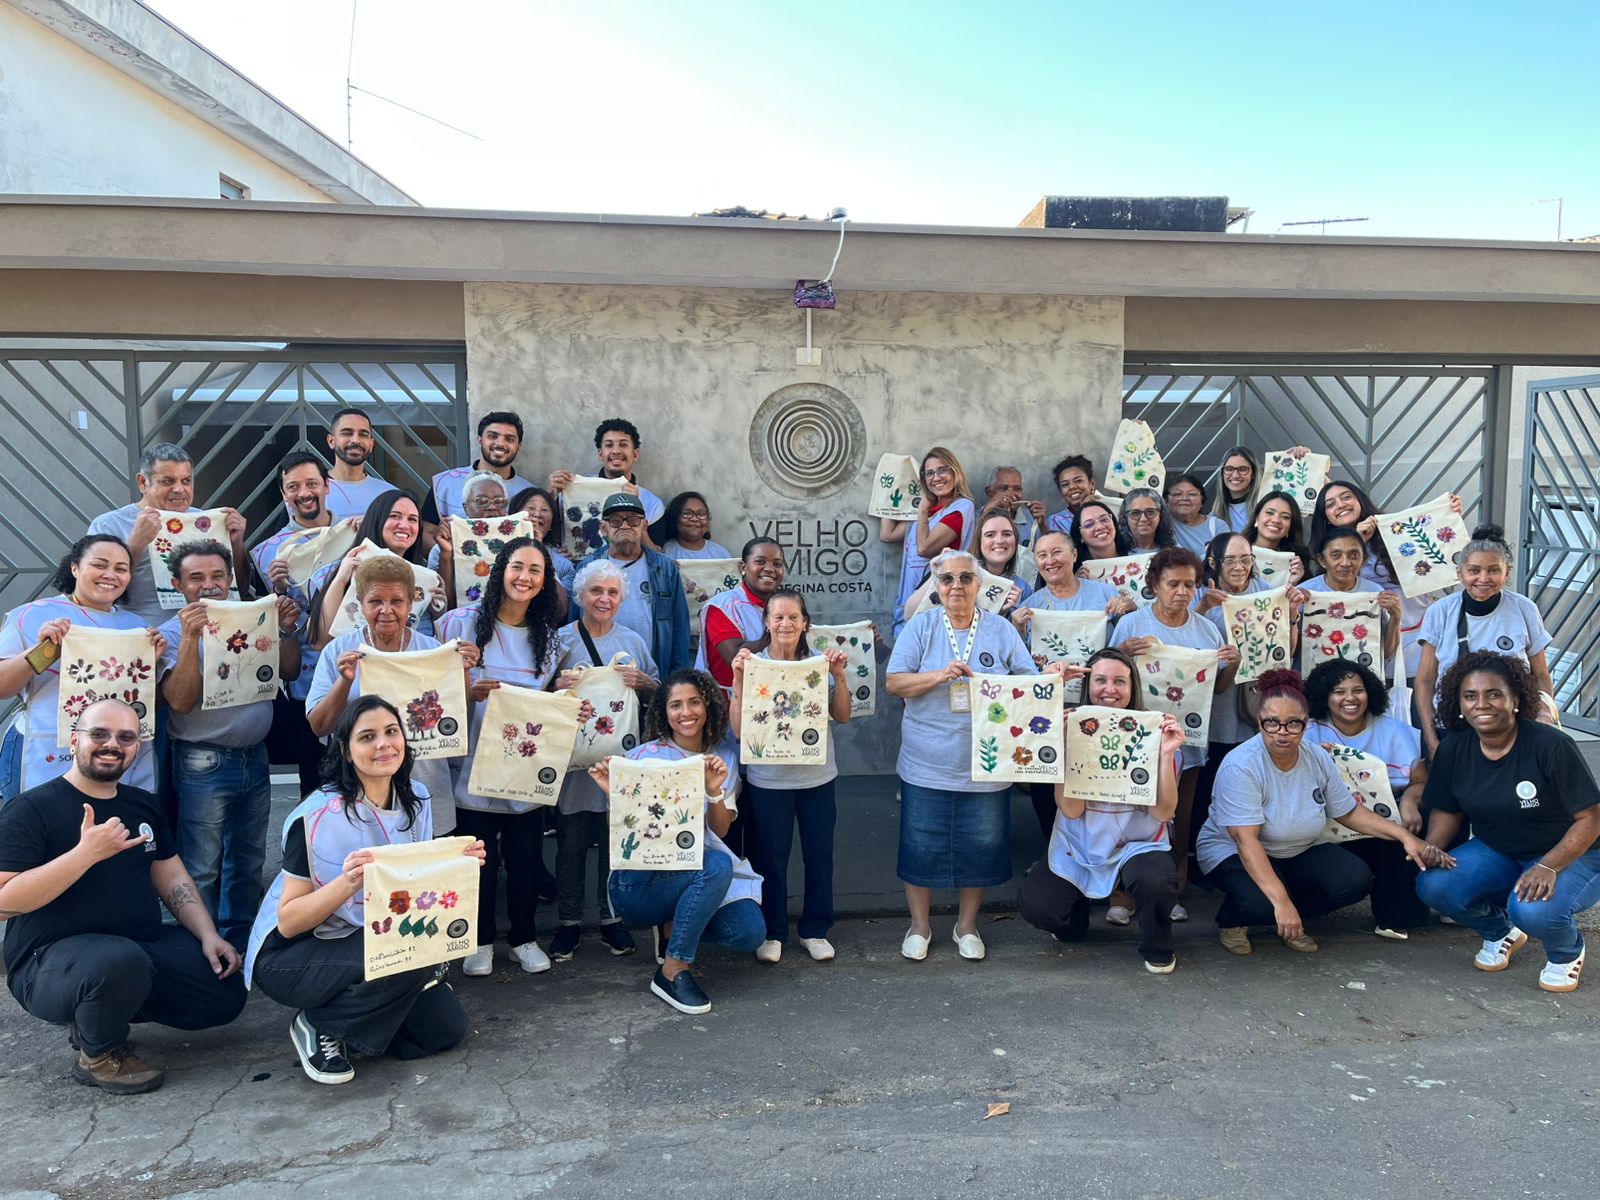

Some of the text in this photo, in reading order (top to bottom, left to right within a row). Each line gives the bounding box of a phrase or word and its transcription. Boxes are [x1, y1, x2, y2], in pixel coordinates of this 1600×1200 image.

[749, 520, 868, 547] VELHO
[783, 549, 868, 576] MIGO
[829, 582, 873, 593] COSTA
